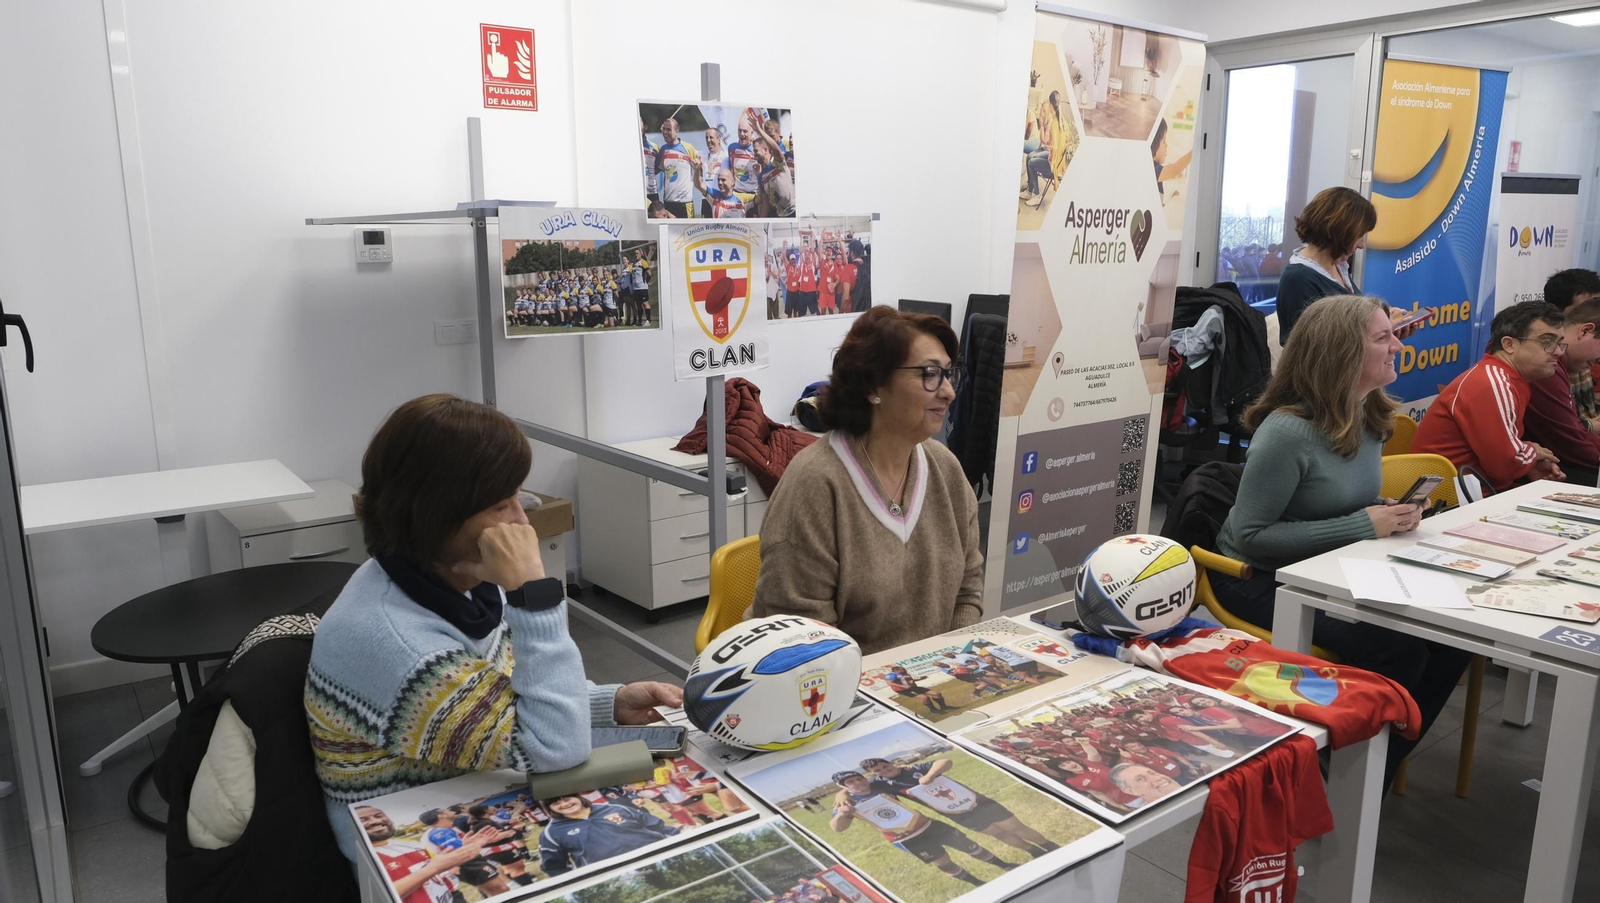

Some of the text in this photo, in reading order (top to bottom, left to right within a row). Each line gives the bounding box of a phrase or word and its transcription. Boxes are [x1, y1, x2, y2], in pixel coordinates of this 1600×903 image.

[489, 86, 532, 96] PULSADOR
[1392, 79, 1424, 92] Asociación
[1456, 88, 1471, 96] para
[487, 97, 534, 107] DE ALARMA
[1390, 96, 1397, 106] el
[1426, 98, 1434, 108] de
[1434, 99, 1452, 109] Down
[1394, 238, 1437, 275] Asalsido
[1441, 193, 1466, 234] Down
[1464, 125, 1486, 192] Almería
[539, 210, 623, 238] URA CLAN
[1065, 201, 1130, 235] Asperger
[686, 223, 748, 237] Unión Rugby Almería
[1510, 225, 1554, 249] DOWN
[696, 248, 741, 263] URA
[1069, 234, 1126, 264] Almería
[689, 343, 756, 371] CLAN
[1399, 342, 1458, 374] Down
[1140, 539, 1167, 556] CLAN
[1135, 580, 1194, 621] GERIT
[711, 618, 806, 665] GERIT
[1555, 630, 1596, 647] 25
[1230, 640, 1252, 655] CLA
[1057, 652, 1089, 665] CLAN
[803, 678, 823, 689] URA
[789, 711, 832, 736] CLAN
[947, 797, 971, 810] CLAN
[1269, 859, 1286, 867] Rug
